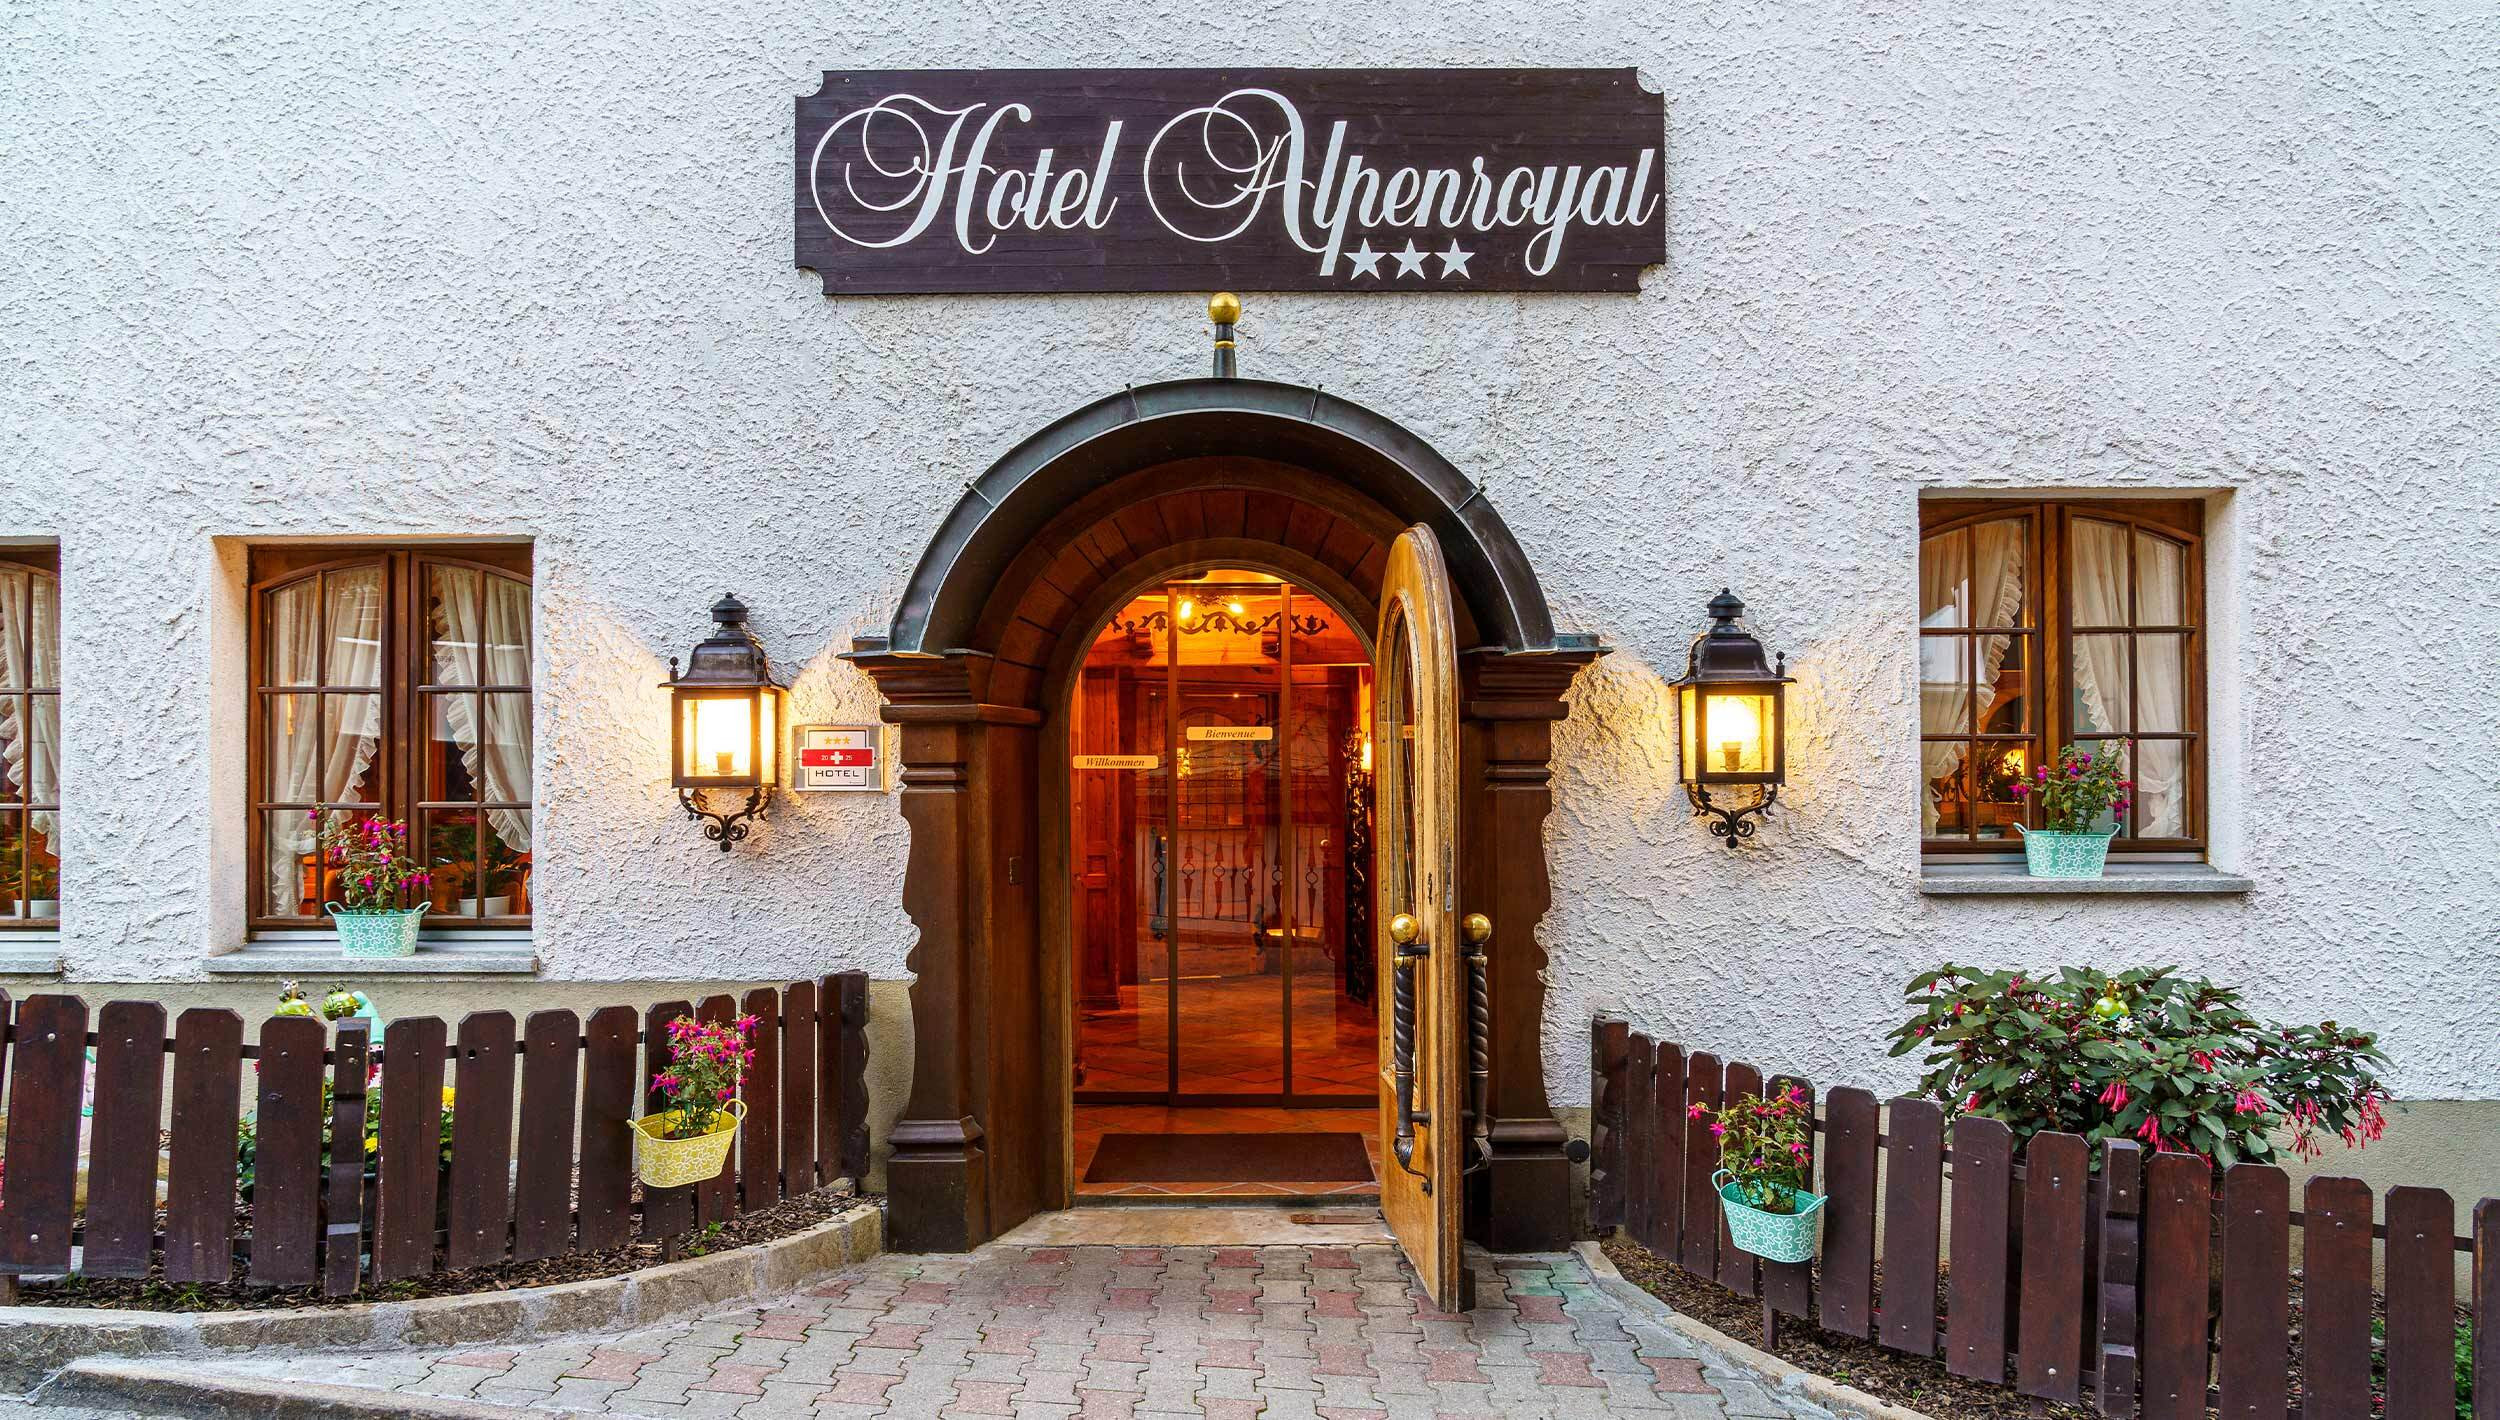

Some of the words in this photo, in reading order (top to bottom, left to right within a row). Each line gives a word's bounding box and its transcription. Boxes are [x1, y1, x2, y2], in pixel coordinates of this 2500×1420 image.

[811, 93, 1124, 255] Hotel
[1144, 89, 1660, 277] Alpenroyal
[1205, 729, 1256, 738] Bienvenue
[1086, 757, 1145, 767] Willkommen
[815, 769, 860, 777] HOTEL
